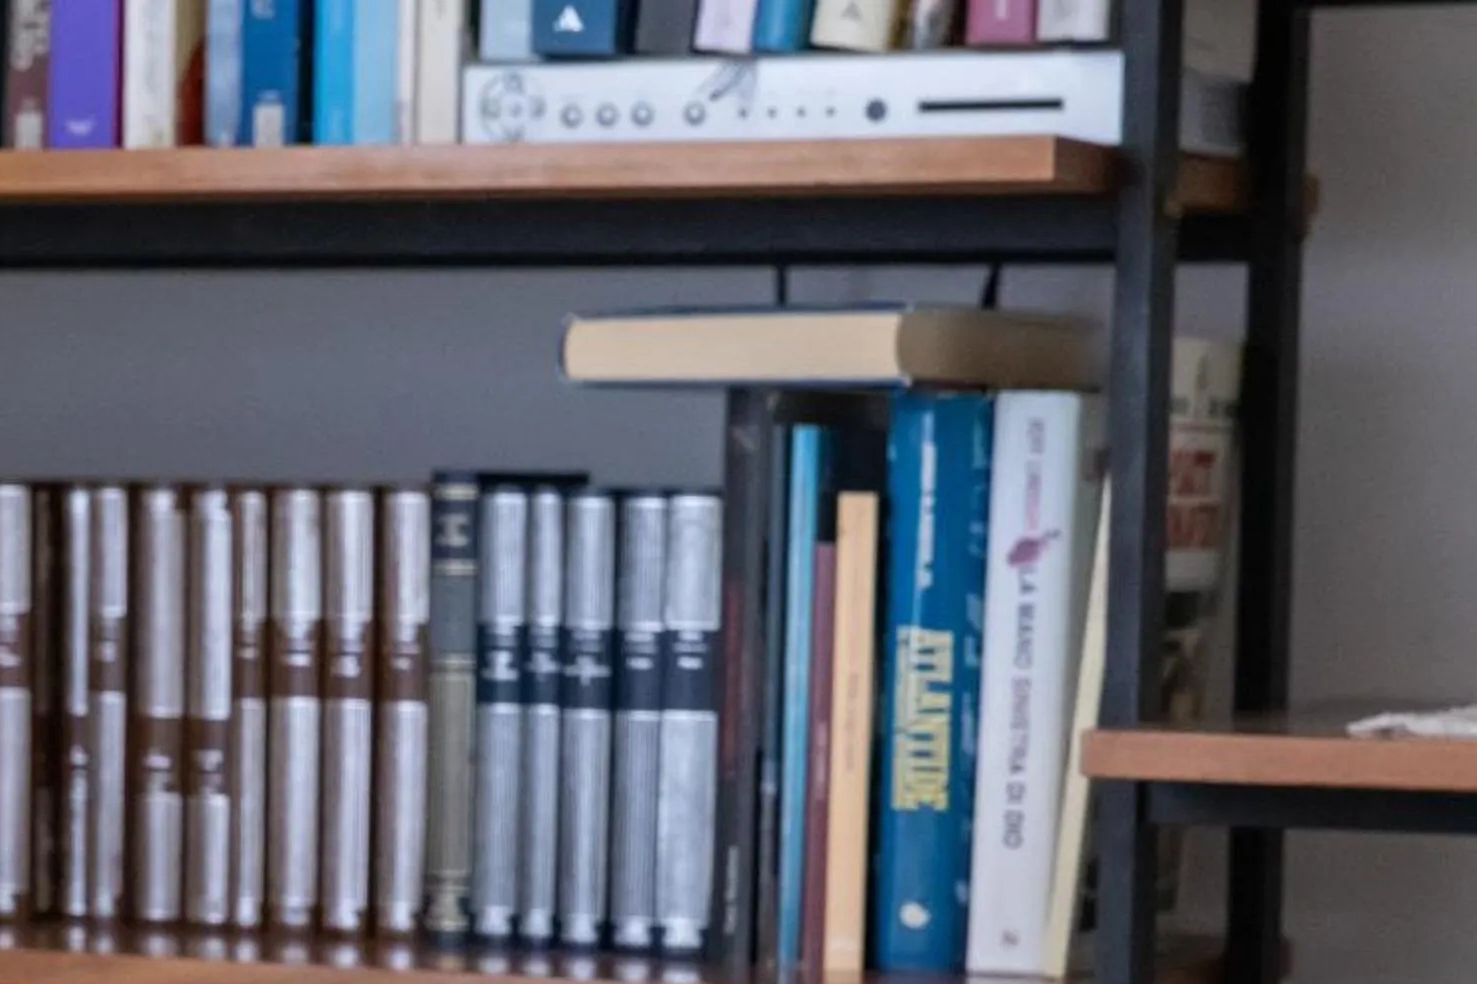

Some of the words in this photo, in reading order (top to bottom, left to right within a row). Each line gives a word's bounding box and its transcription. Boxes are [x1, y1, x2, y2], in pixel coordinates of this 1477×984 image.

[1017, 567, 1039, 594] LA
[1012, 603, 1037, 667] MANO
[892, 624, 955, 811] ATLANTIDE
[1008, 677, 1033, 775] SINISTRA
[1005, 783, 1028, 805] DI
[1002, 809, 1026, 850] DIO
